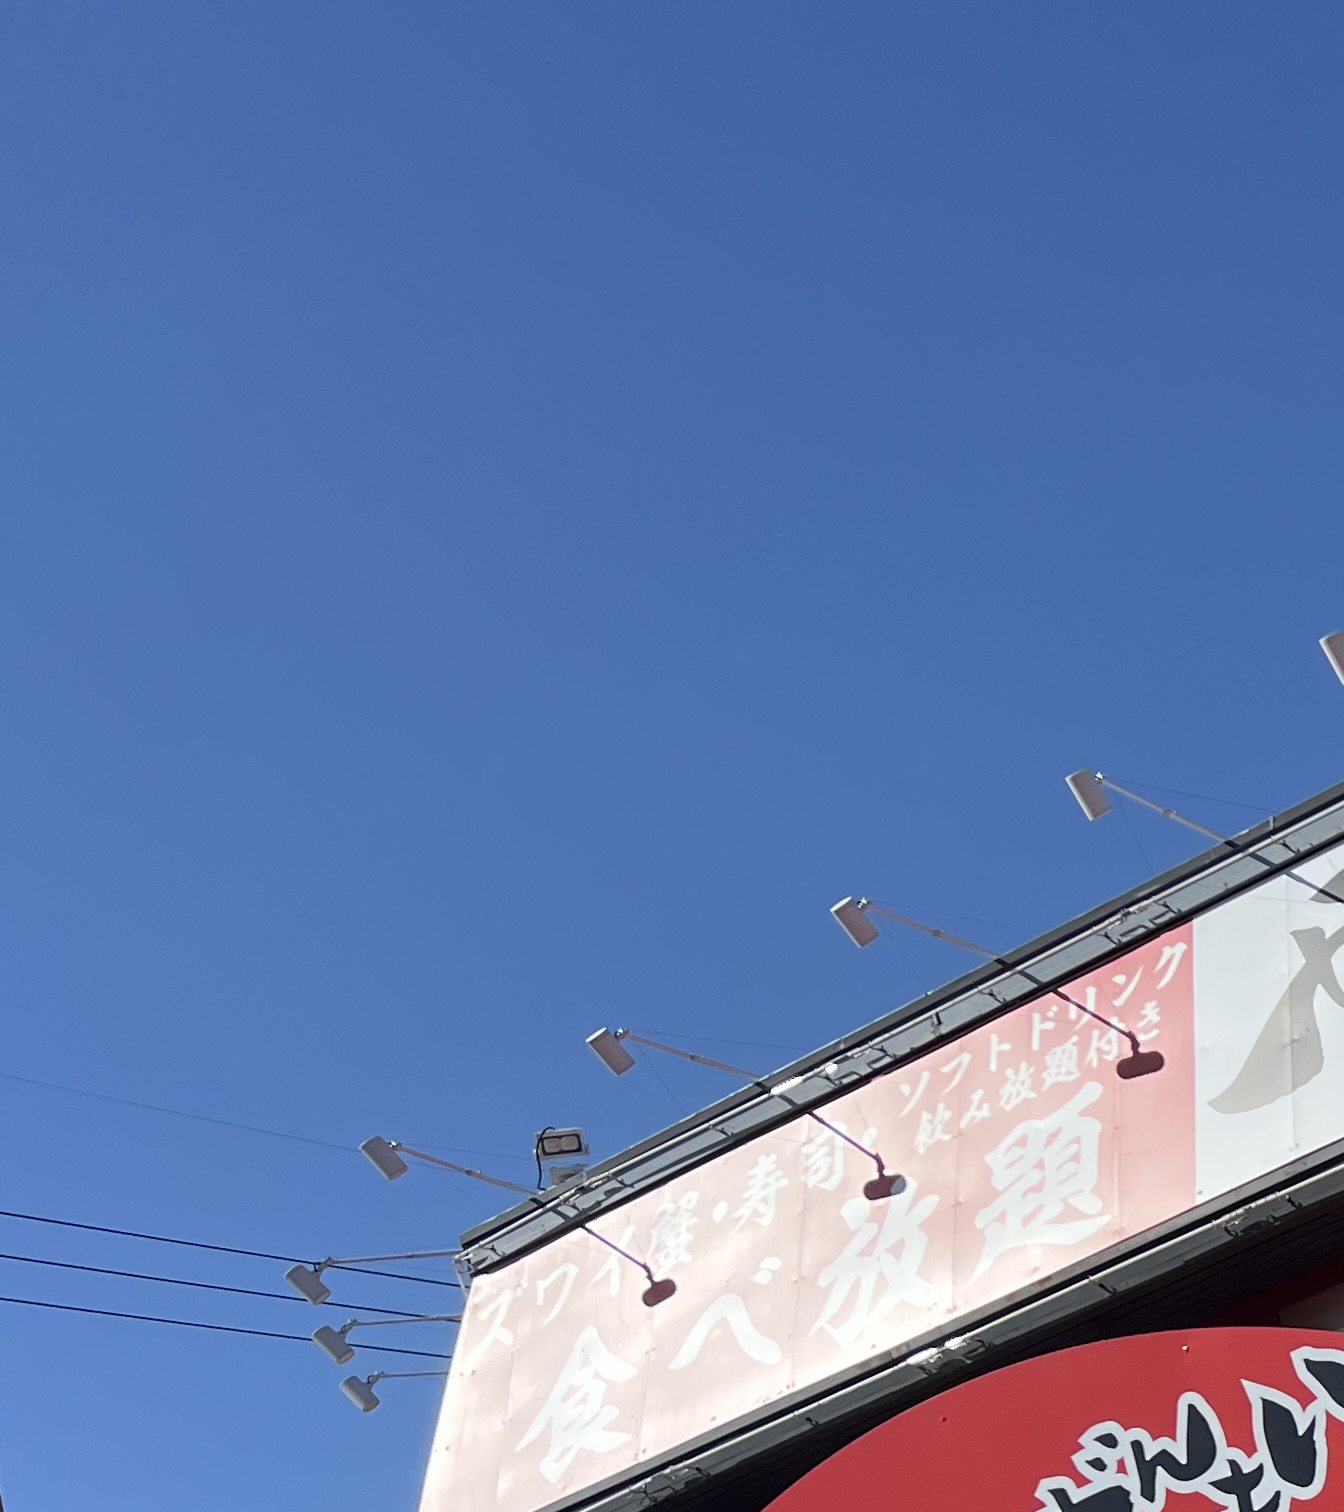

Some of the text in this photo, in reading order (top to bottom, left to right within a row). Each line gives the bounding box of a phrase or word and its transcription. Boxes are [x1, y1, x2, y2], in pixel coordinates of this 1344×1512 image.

[899, 942, 1187, 1117] ソフトドリンク
[914, 1001, 1161, 1155] 飲み放題付き
[515, 1082, 1112, 1483] 食べ放題
